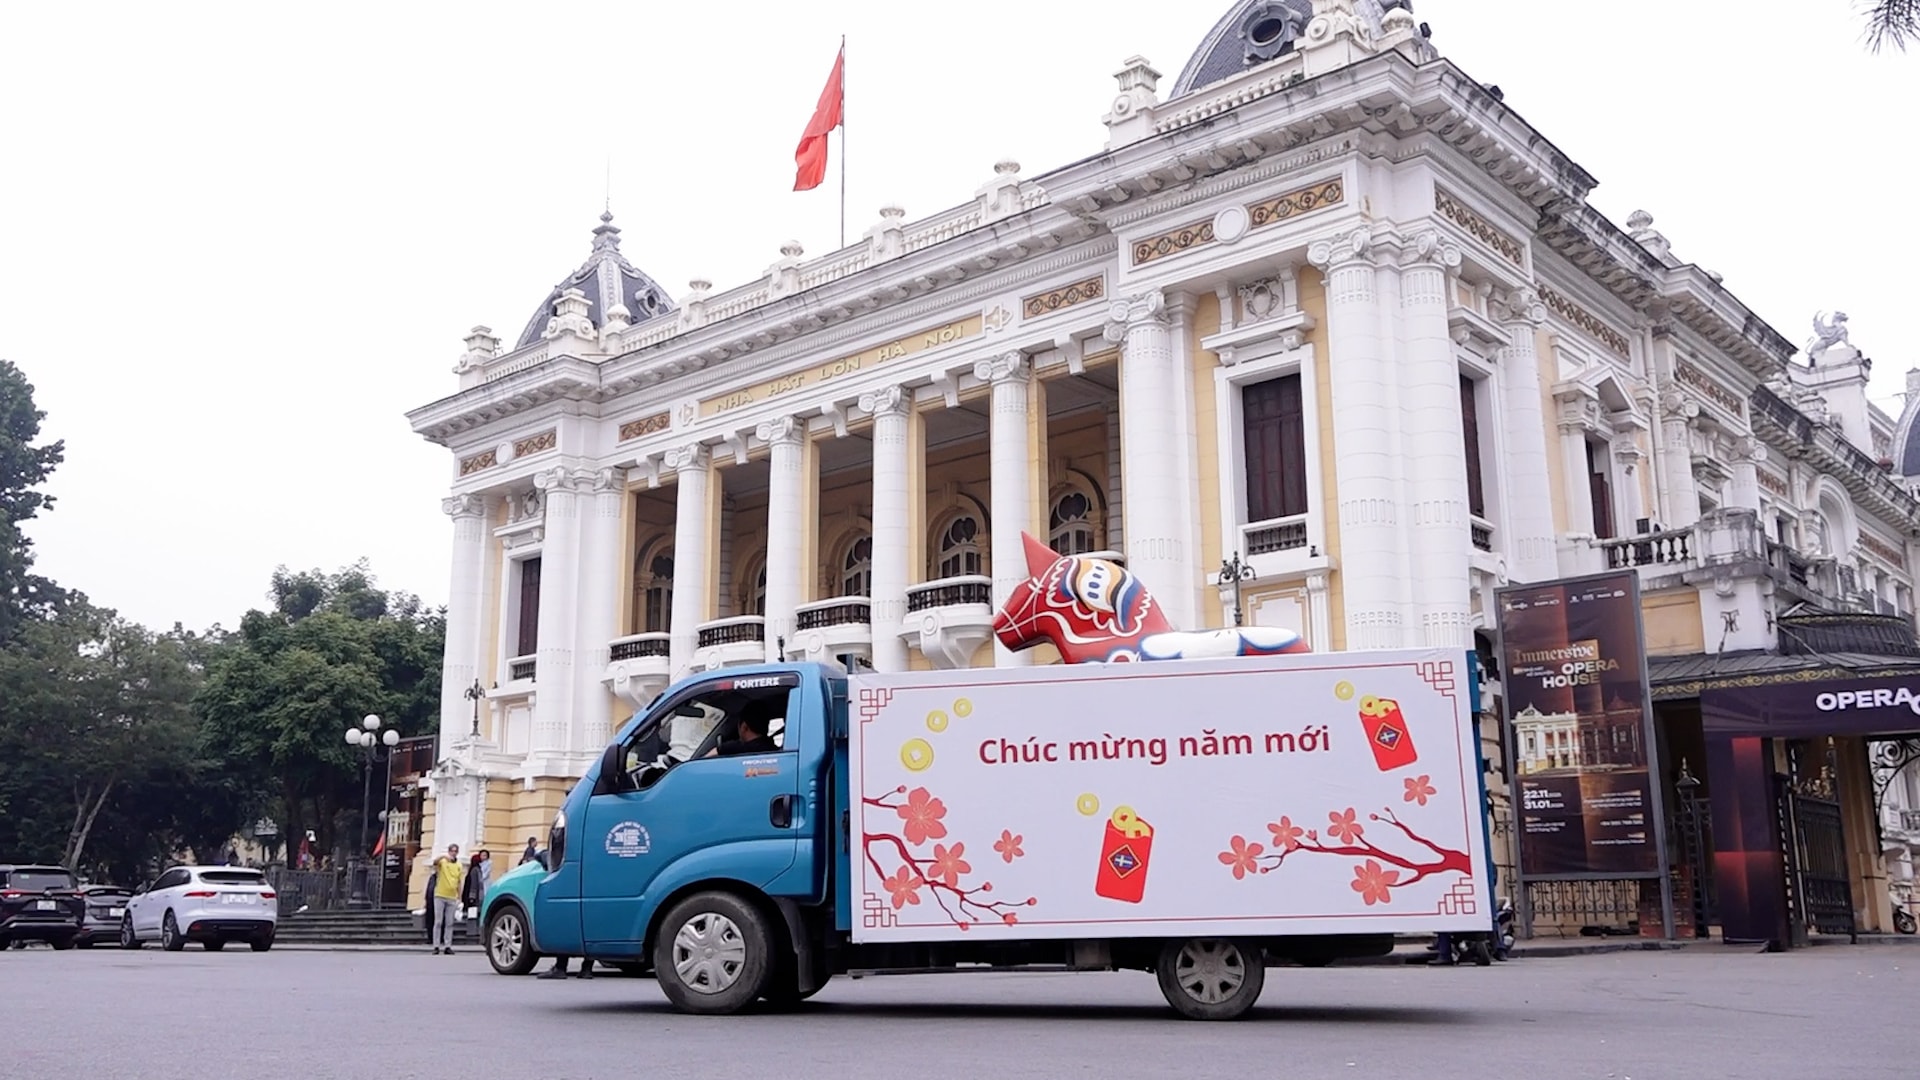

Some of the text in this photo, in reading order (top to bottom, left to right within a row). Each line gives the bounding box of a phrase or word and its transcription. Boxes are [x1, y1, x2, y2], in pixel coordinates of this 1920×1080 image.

[717, 388, 754, 413] NHÀ
[768, 374, 805, 398] HÁT
[877, 340, 907, 363] HÀ
[1513, 644, 1594, 663] Immersive
[1561, 658, 1620, 676] OPERA
[1542, 672, 1601, 689] HOUSE
[979, 725, 1331, 766] Chúc mừng năm mới
